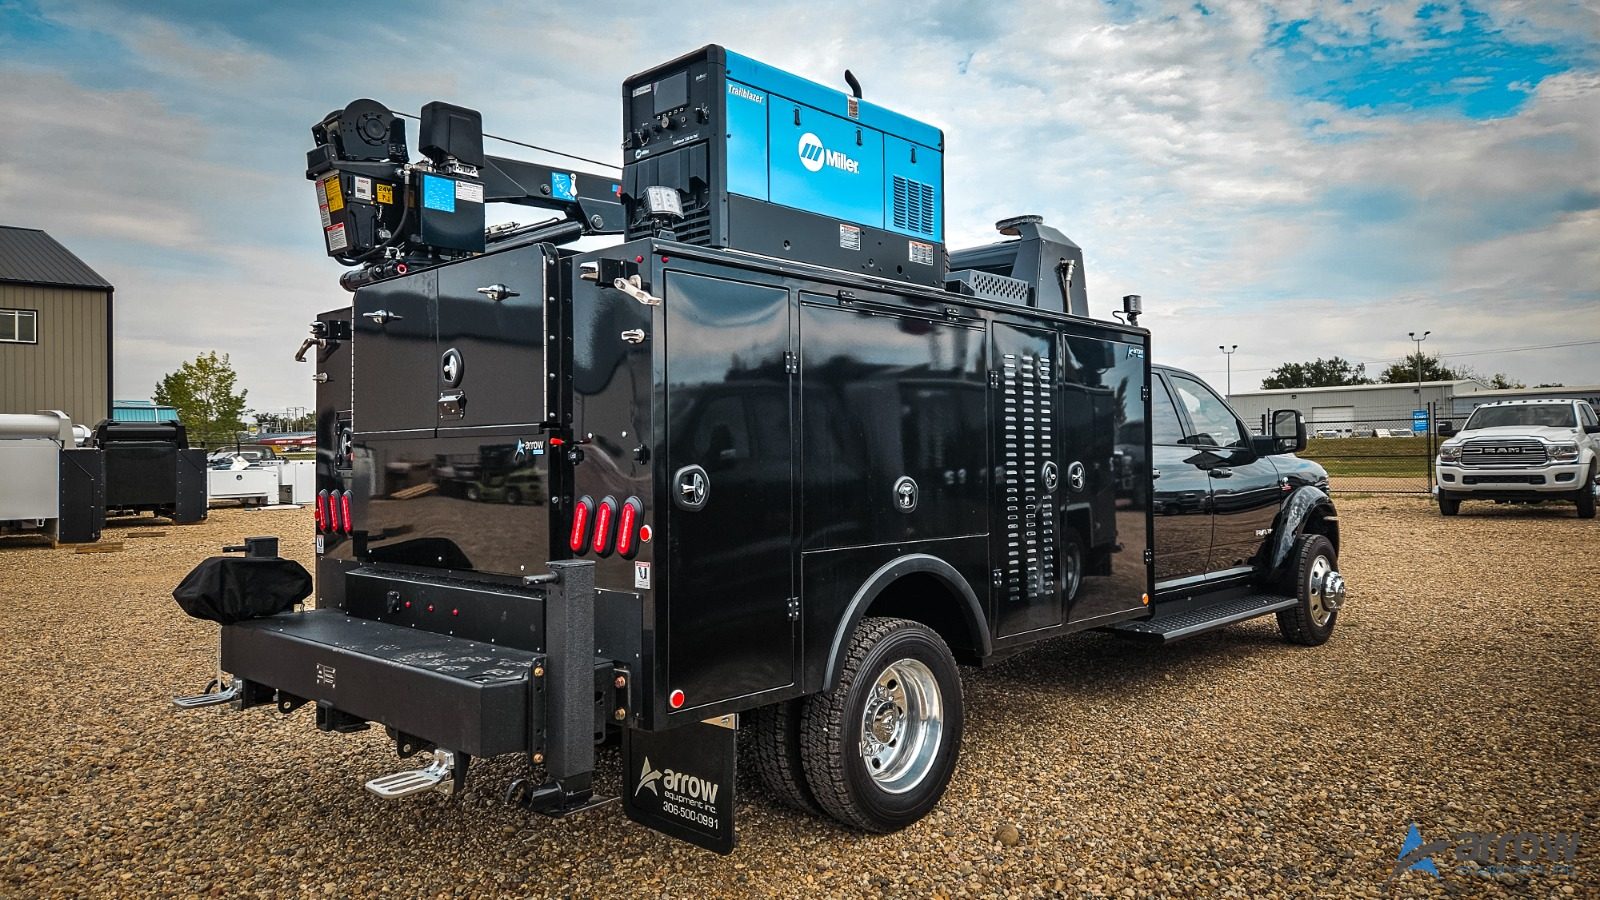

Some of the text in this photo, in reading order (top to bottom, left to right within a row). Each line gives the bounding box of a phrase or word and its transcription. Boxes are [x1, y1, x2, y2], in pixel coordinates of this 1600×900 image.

[728, 84, 763, 103] Trailblazer
[525, 441, 544, 449] arrow
[664, 769, 718, 804] arrow
[664, 791, 703, 809] equipment
[663, 801, 719, 830] 306-500-0991
